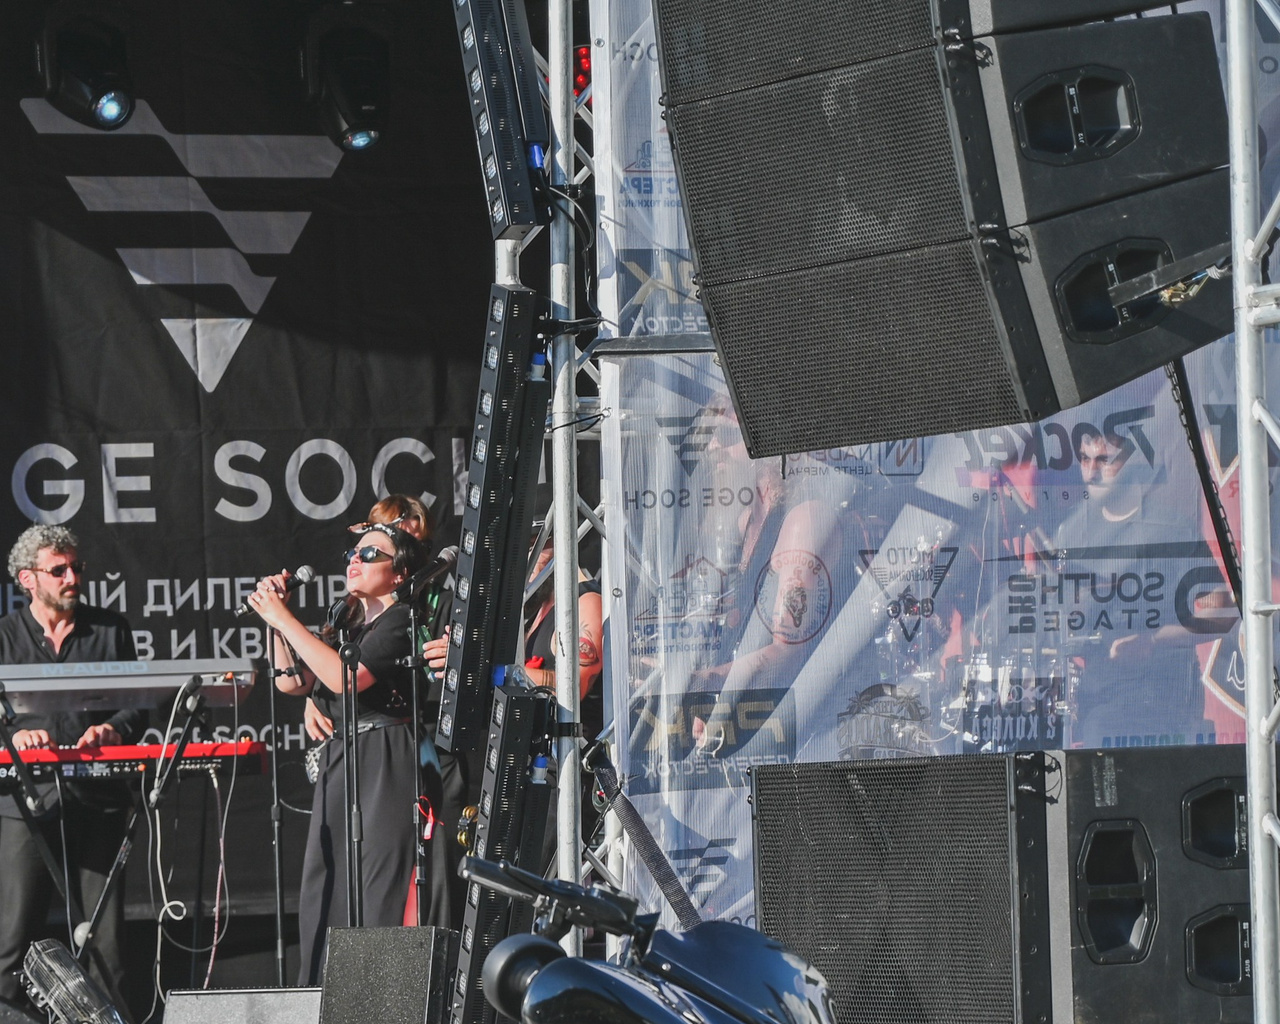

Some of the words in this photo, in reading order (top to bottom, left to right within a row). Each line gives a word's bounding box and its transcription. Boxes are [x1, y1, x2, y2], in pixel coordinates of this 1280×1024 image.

[170, 628, 198, 660] И
[41, 661, 149, 676] M-AUDIO
[7, 765, 18, 778] 4
